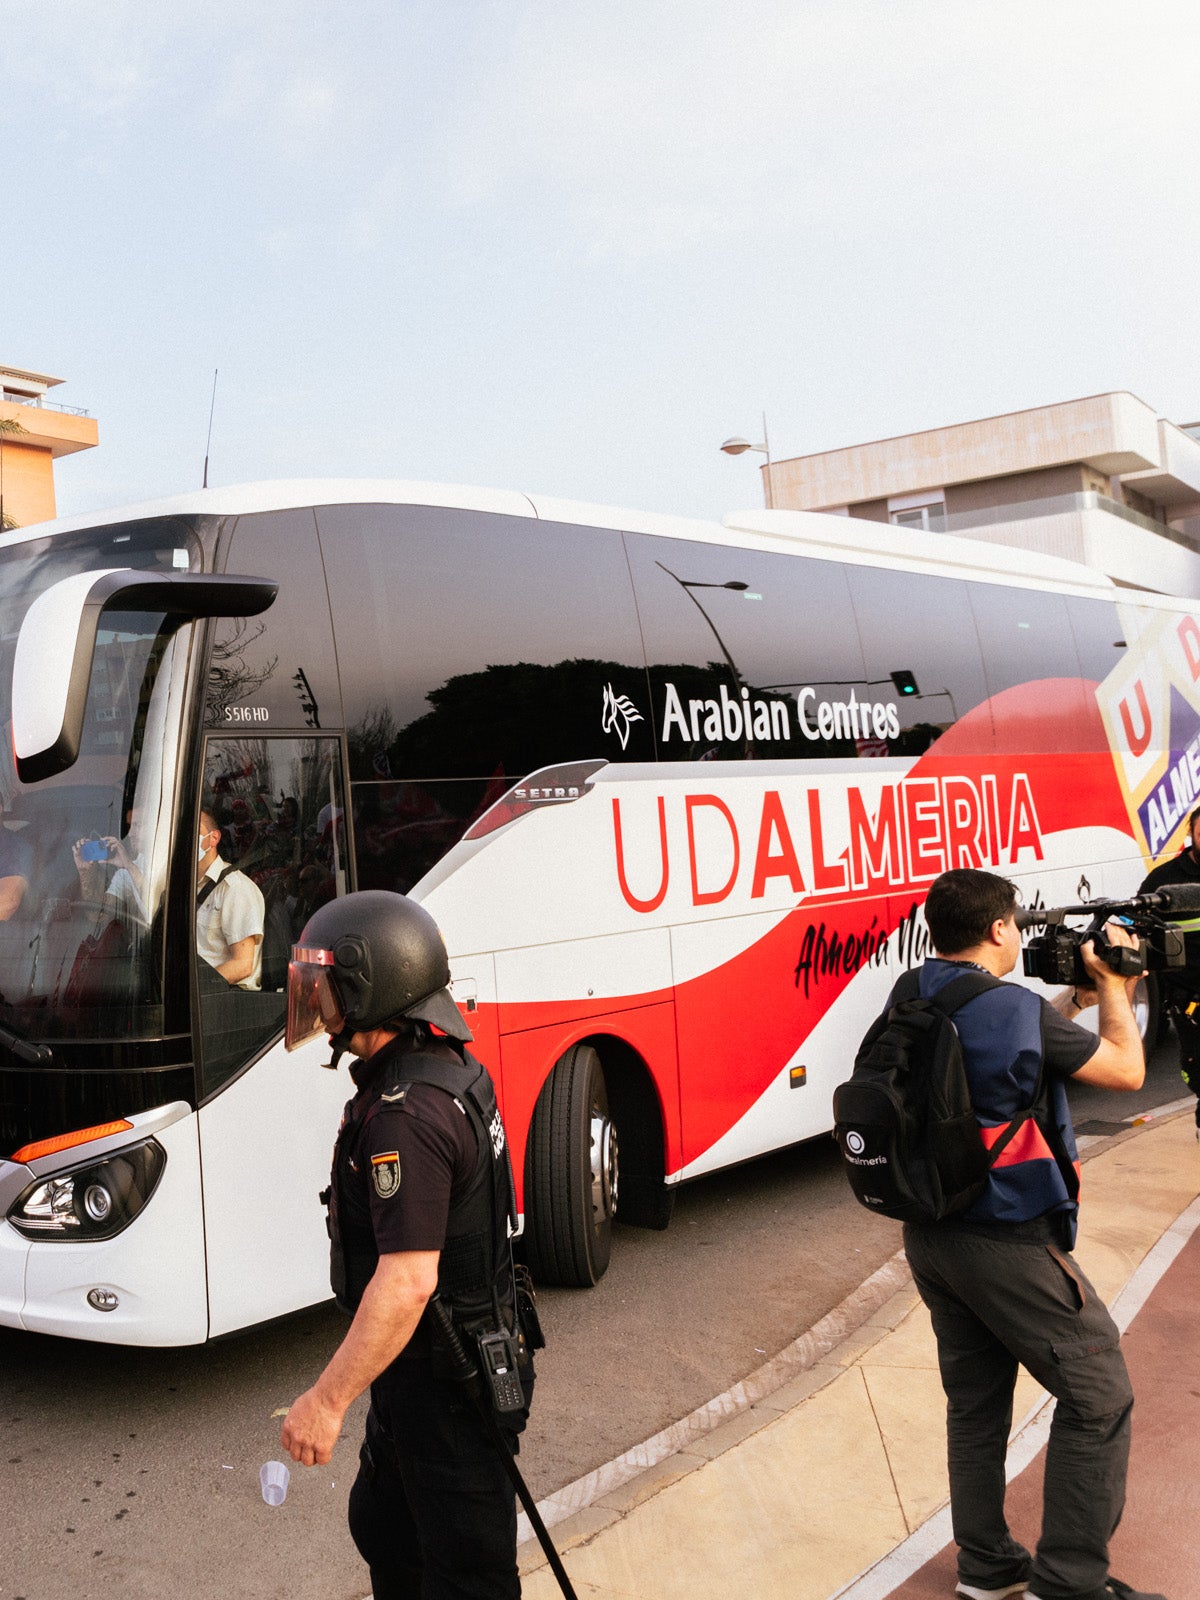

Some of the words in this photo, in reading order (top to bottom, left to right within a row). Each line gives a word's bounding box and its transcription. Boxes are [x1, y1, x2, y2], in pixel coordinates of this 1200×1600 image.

[233, 706, 251, 721] 516
[252, 707, 269, 721] HD
[662, 683, 791, 742] Arabian
[797, 687, 901, 741] Centres
[514, 787, 579, 799] SETRA
[794, 915, 889, 1000] Almería
